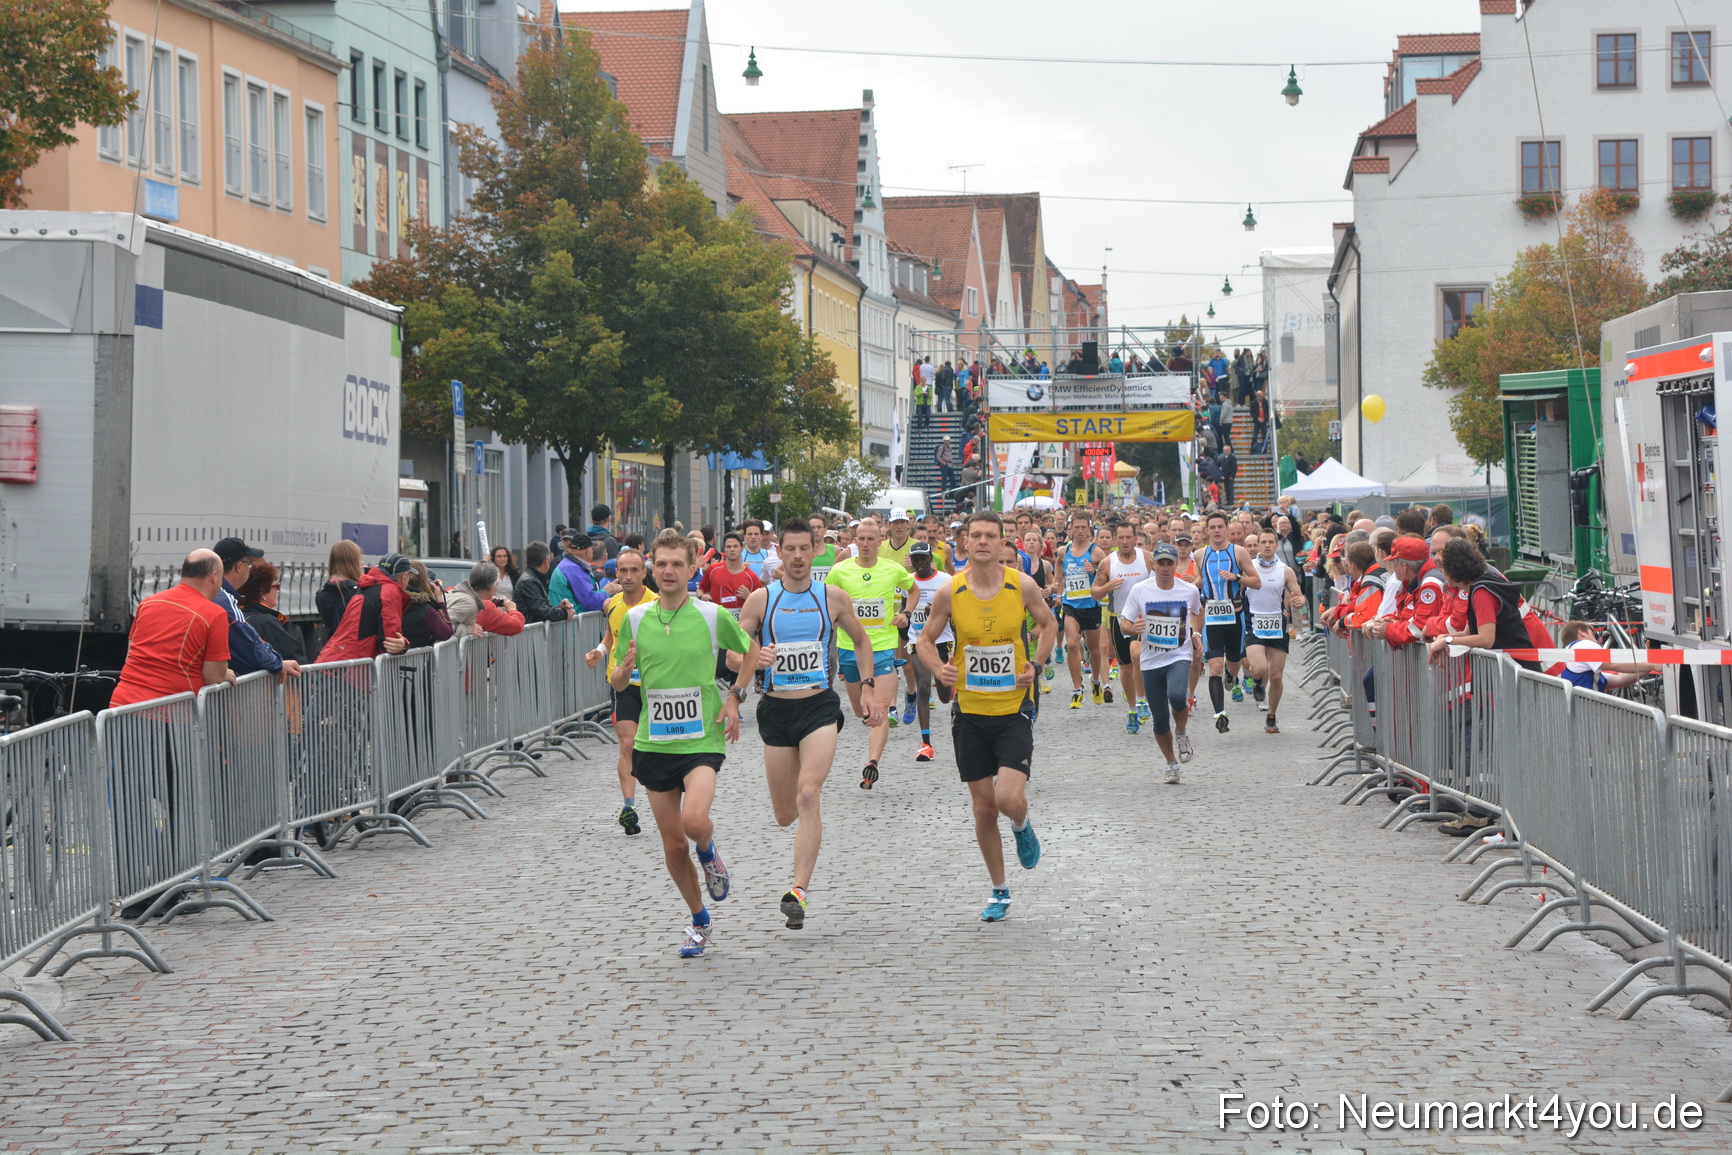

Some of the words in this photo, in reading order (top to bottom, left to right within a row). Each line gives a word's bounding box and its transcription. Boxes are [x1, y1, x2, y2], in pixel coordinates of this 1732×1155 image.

[1048, 385, 1072, 393] BMW
[1073, 384, 1153, 393] EfficientDynamics
[343, 374, 390, 446] BOCK
[1055, 418, 1127, 435] START
[1069, 580, 1085, 591] 612
[857, 605, 879, 618] 635
[1207, 604, 1232, 616] 2090
[1149, 623, 1177, 637] 2013
[1257, 620, 1280, 630] 3376
[776, 652, 819, 672] 2002
[969, 656, 1011, 674] 2062
[787, 675, 811, 684] Marco
[979, 677, 1001, 686] Stefan
[664, 692, 692, 700] Neumarkt
[653, 699, 698, 721] 2000
[666, 725, 685, 734] Lang
